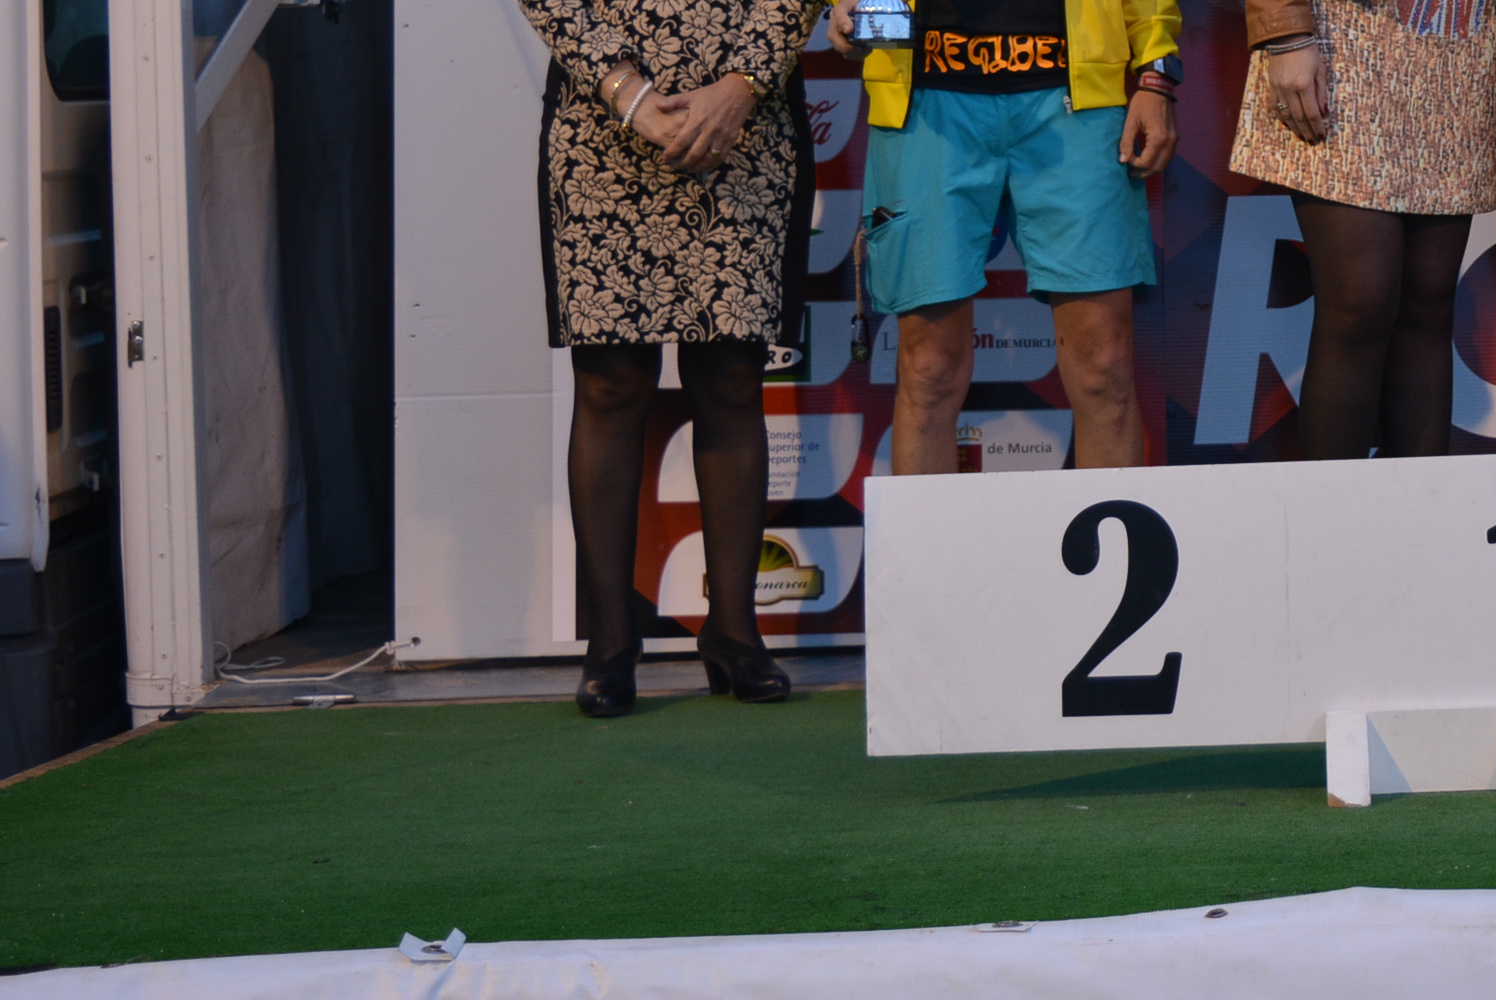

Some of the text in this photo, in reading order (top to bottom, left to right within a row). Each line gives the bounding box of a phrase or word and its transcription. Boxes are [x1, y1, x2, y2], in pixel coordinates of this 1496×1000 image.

[808, 441, 820, 451] de
[987, 442, 1052, 454] de Murcia
[1062, 500, 1182, 717] 2
